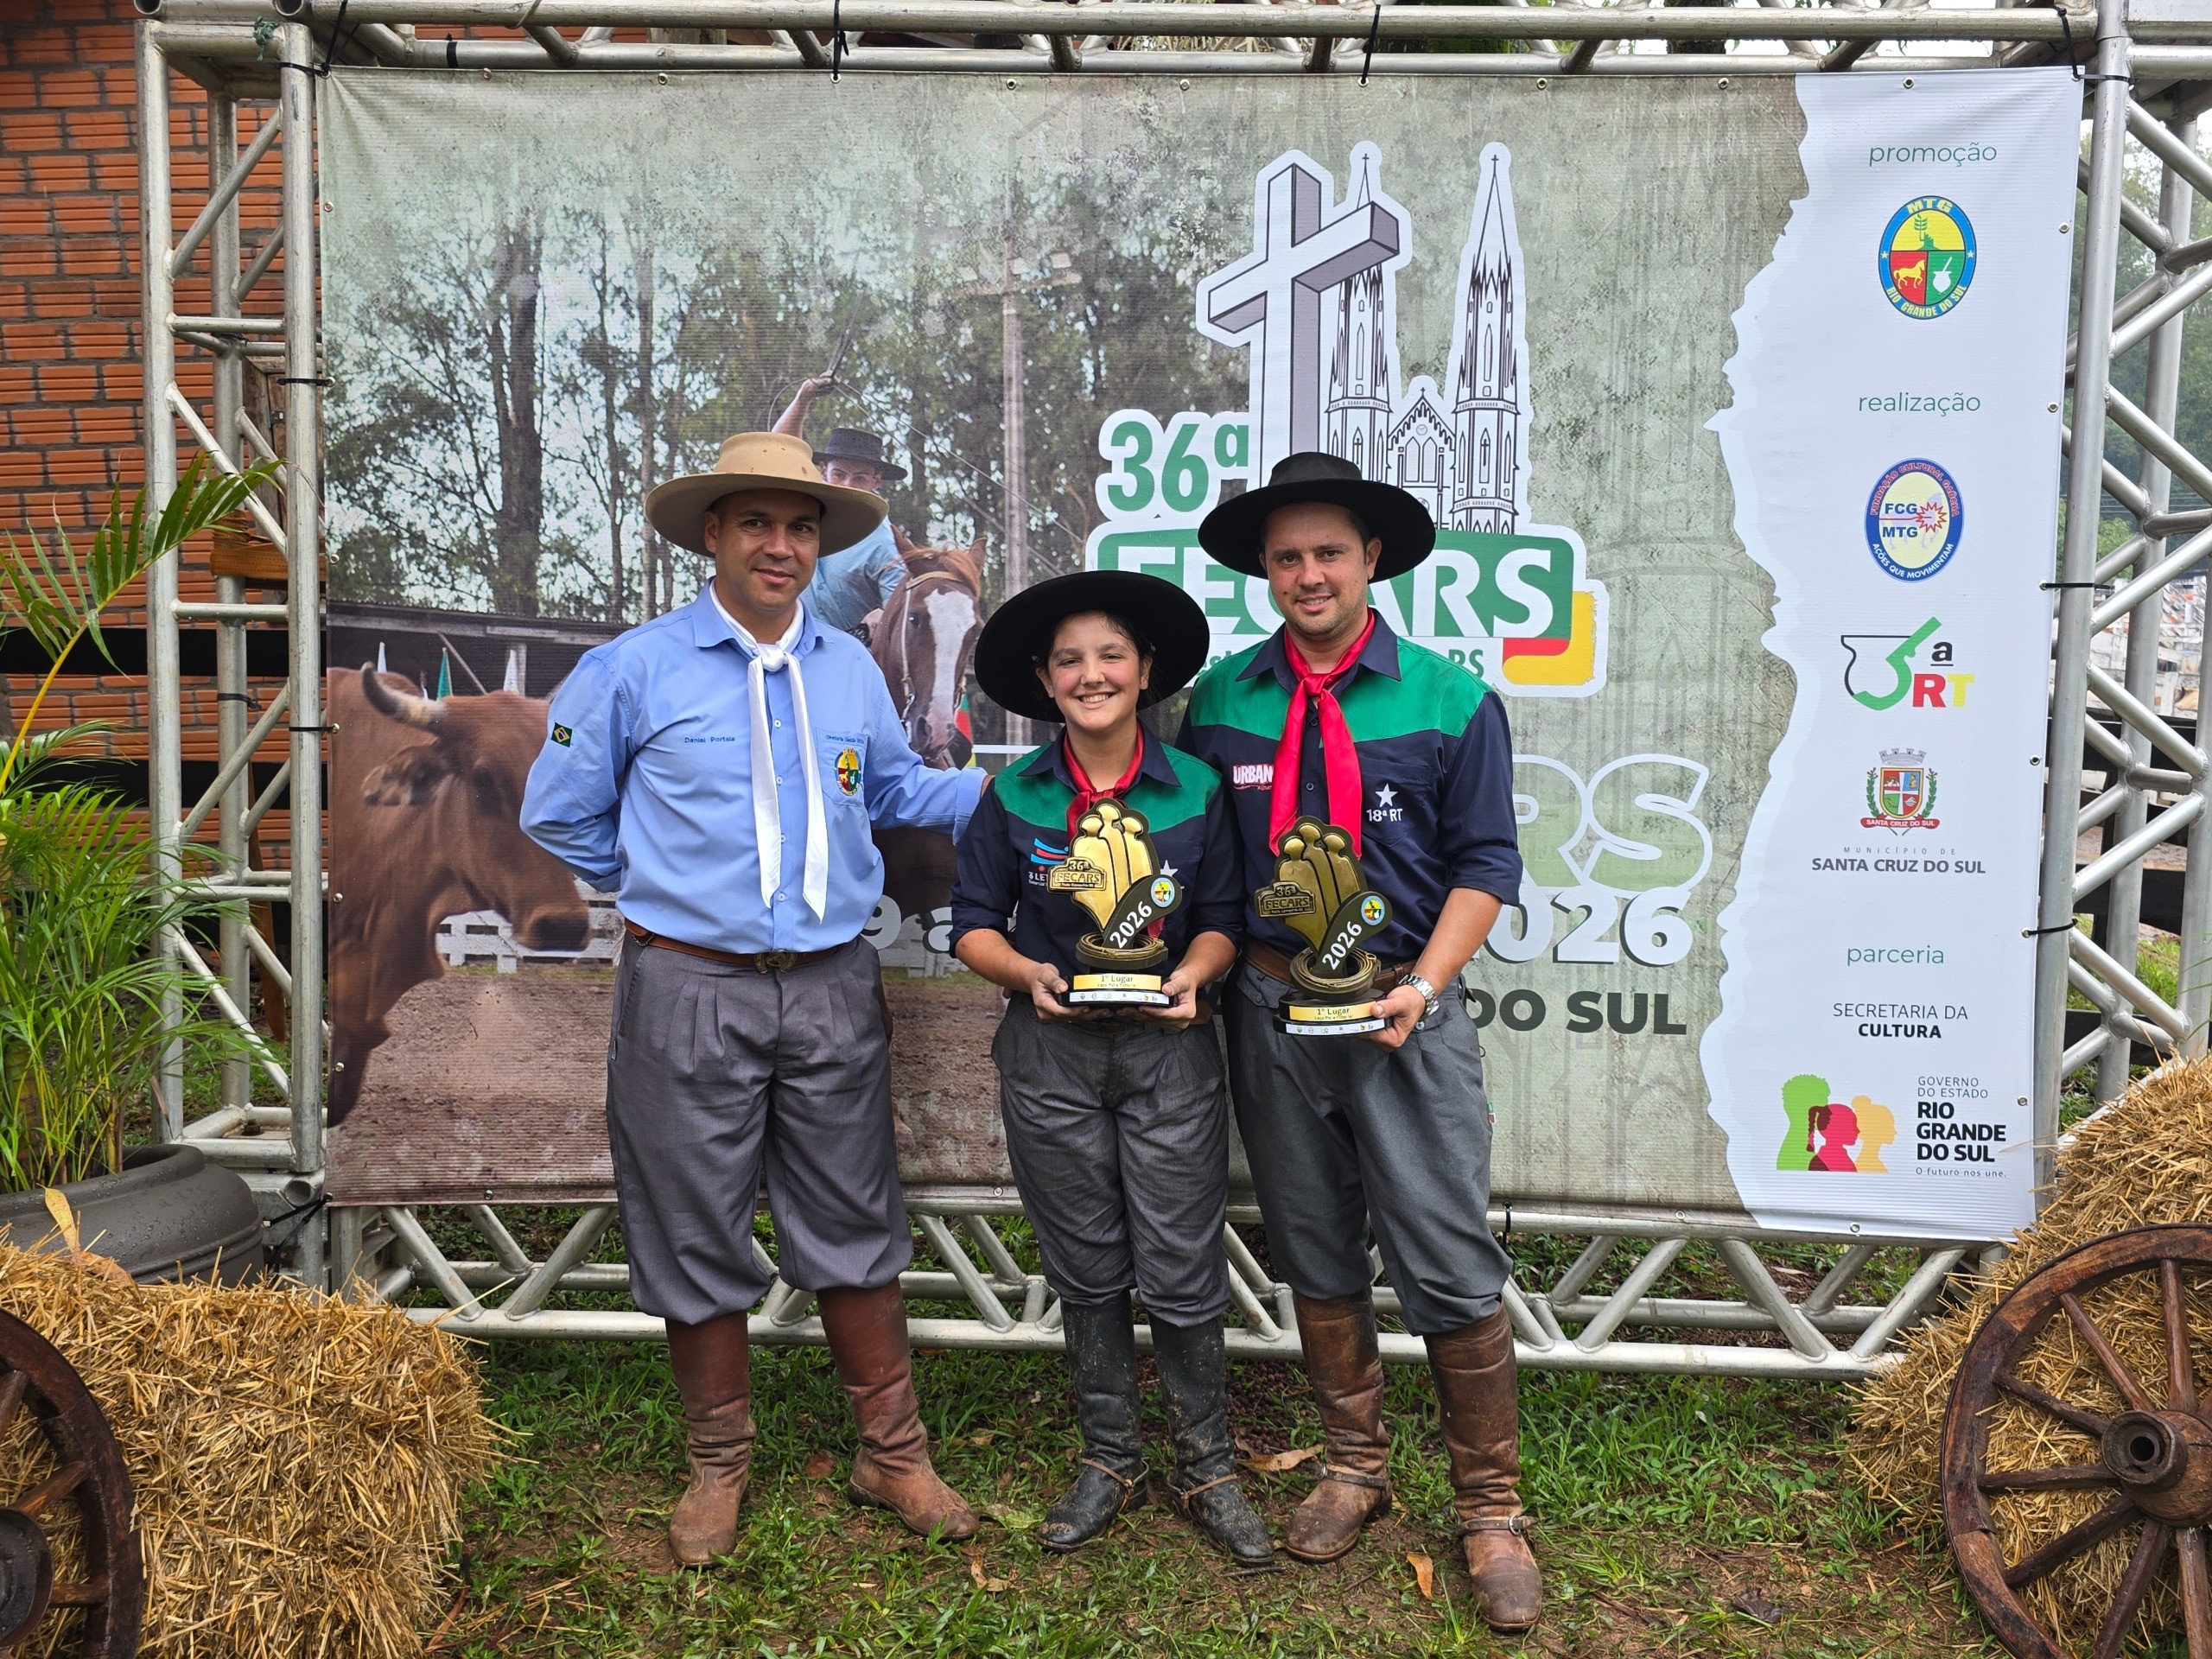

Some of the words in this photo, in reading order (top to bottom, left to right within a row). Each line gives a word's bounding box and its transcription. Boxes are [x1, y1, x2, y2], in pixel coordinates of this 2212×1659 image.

[1869, 142, 1998, 168] promoção
[1906, 198, 1954, 214] MTG
[1886, 286, 1902, 303] RIO
[1901, 302, 1937, 318] GRANDE
[1938, 297, 1953, 312] DO
[1950, 284, 1967, 302] SUL
[1859, 391, 1981, 417] realização
[1870, 470, 1899, 516] FUNDAÇÃO
[1898, 461, 1944, 482] CULTURAL
[1885, 503, 1918, 515] FCG
[1882, 526, 1918, 538] MTG
[1872, 543, 1891, 568] AÇÕES
[1889, 564, 1905, 578] QUE
[1906, 543, 1955, 579] MOVIMENTAM
[1912, 673, 1975, 709] RT
[1389, 808, 1403, 823] RT
[1866, 818, 1889, 827] SANTA
[1843, 845, 1928, 855] MUNICÍPIO
[1811, 857, 1869, 873] SANTA
[1874, 858, 1919, 873] CRUZ
[1923, 860, 1949, 873] DO
[1955, 860, 1986, 874] SUL
[1057, 873, 1101, 883] FECARS
[1265, 897, 1309, 909] FECARS
[1109, 900, 1152, 949] 2026
[1471, 887, 1694, 968] 026
[1322, 920, 1363, 970] 2026
[1847, 944, 1944, 967] parceria
[1111, 975, 1134, 984] Lugar
[1327, 1007, 1350, 1016] Lugar
[1566, 990, 1688, 1036] SUL
[1833, 1002, 1939, 1020] SECRETARIA
[1944, 1005, 1968, 1020] DA
[1858, 1023, 1942, 1039] CULTURA
[1918, 1076, 1979, 1087] GOVERNO
[1917, 1087, 1936, 1097] DO
[1941, 1087, 1988, 1099] ESTADO
[1917, 1101, 1955, 1120] RIO
[1916, 1122, 2007, 1142] GRANDE
[1916, 1142, 1949, 1161] DO
[1954, 1143, 1996, 1163] SUL
[1916, 1166, 1923, 1175] O
[1927, 1166, 1960, 1176] futuro
[1985, 1170, 2007, 1179] une.
